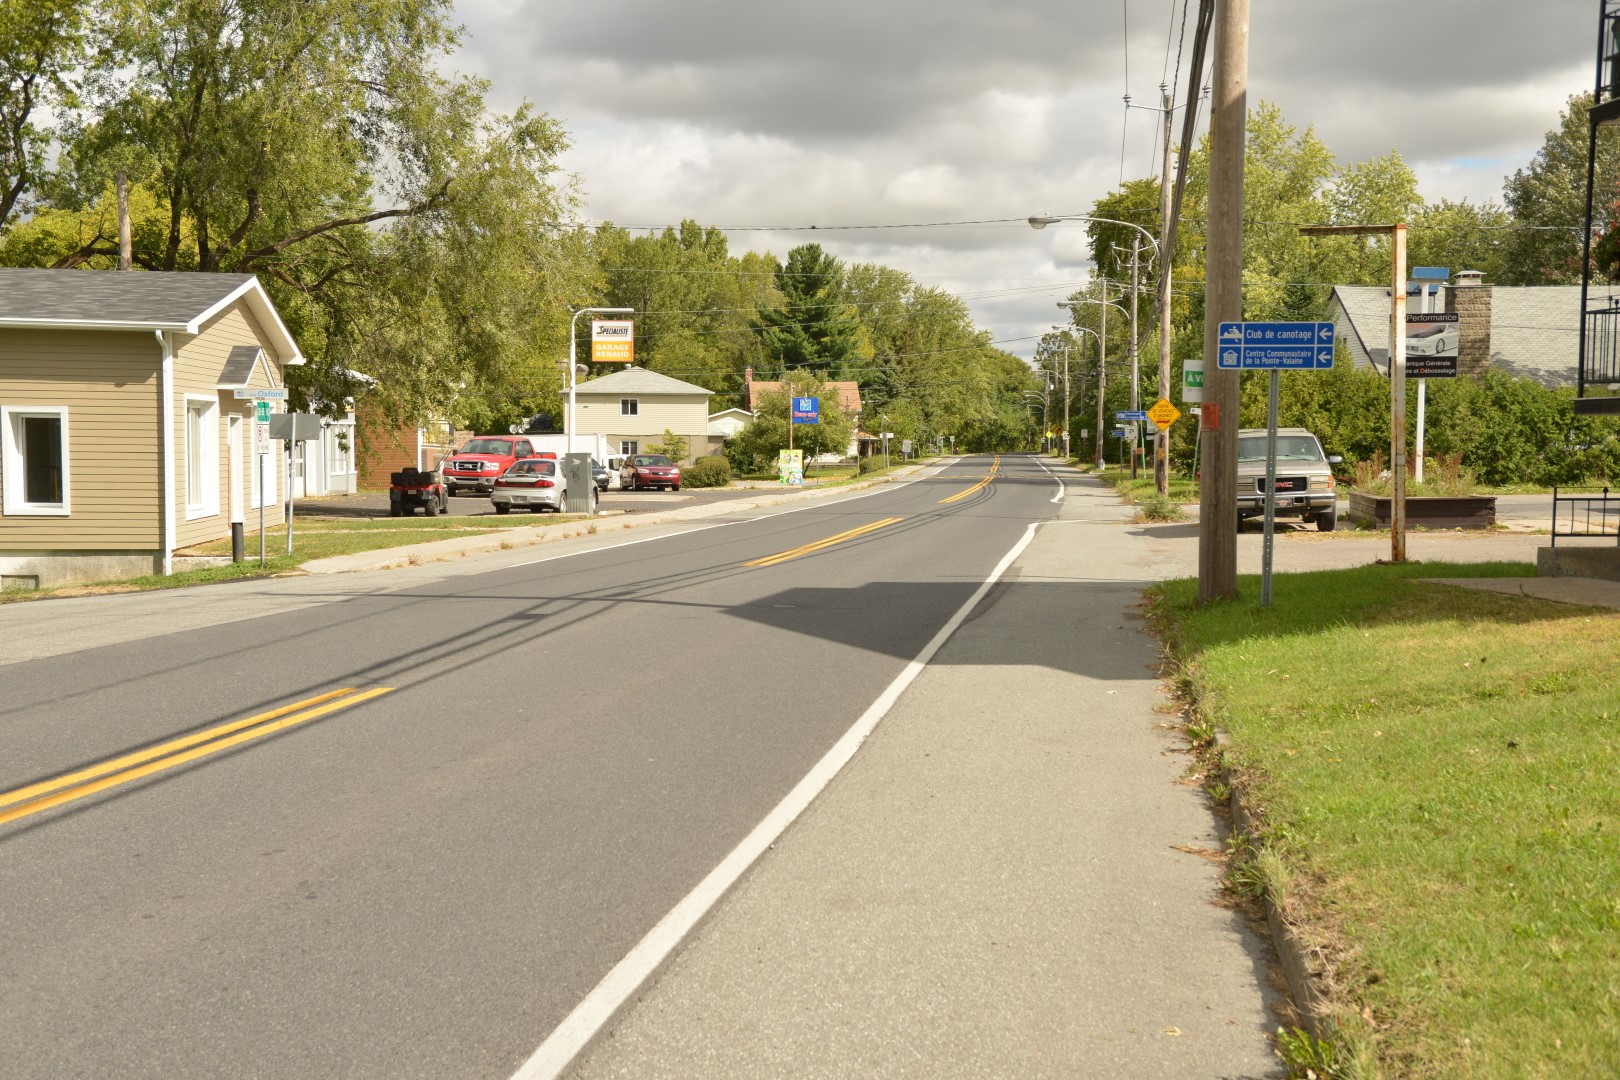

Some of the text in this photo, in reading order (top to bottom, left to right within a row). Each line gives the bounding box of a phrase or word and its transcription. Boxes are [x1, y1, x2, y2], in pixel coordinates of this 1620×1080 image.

[1406, 314, 1458, 322] Performance
[1246, 329, 1312, 341] Club de canotage
[1245, 349, 1312, 358] Centre Communautaire
[1245, 357, 1304, 365] de la Pointe-Valaine
[1420, 367, 1456, 375] Débosselage
[257, 390, 284, 398] Oxford
